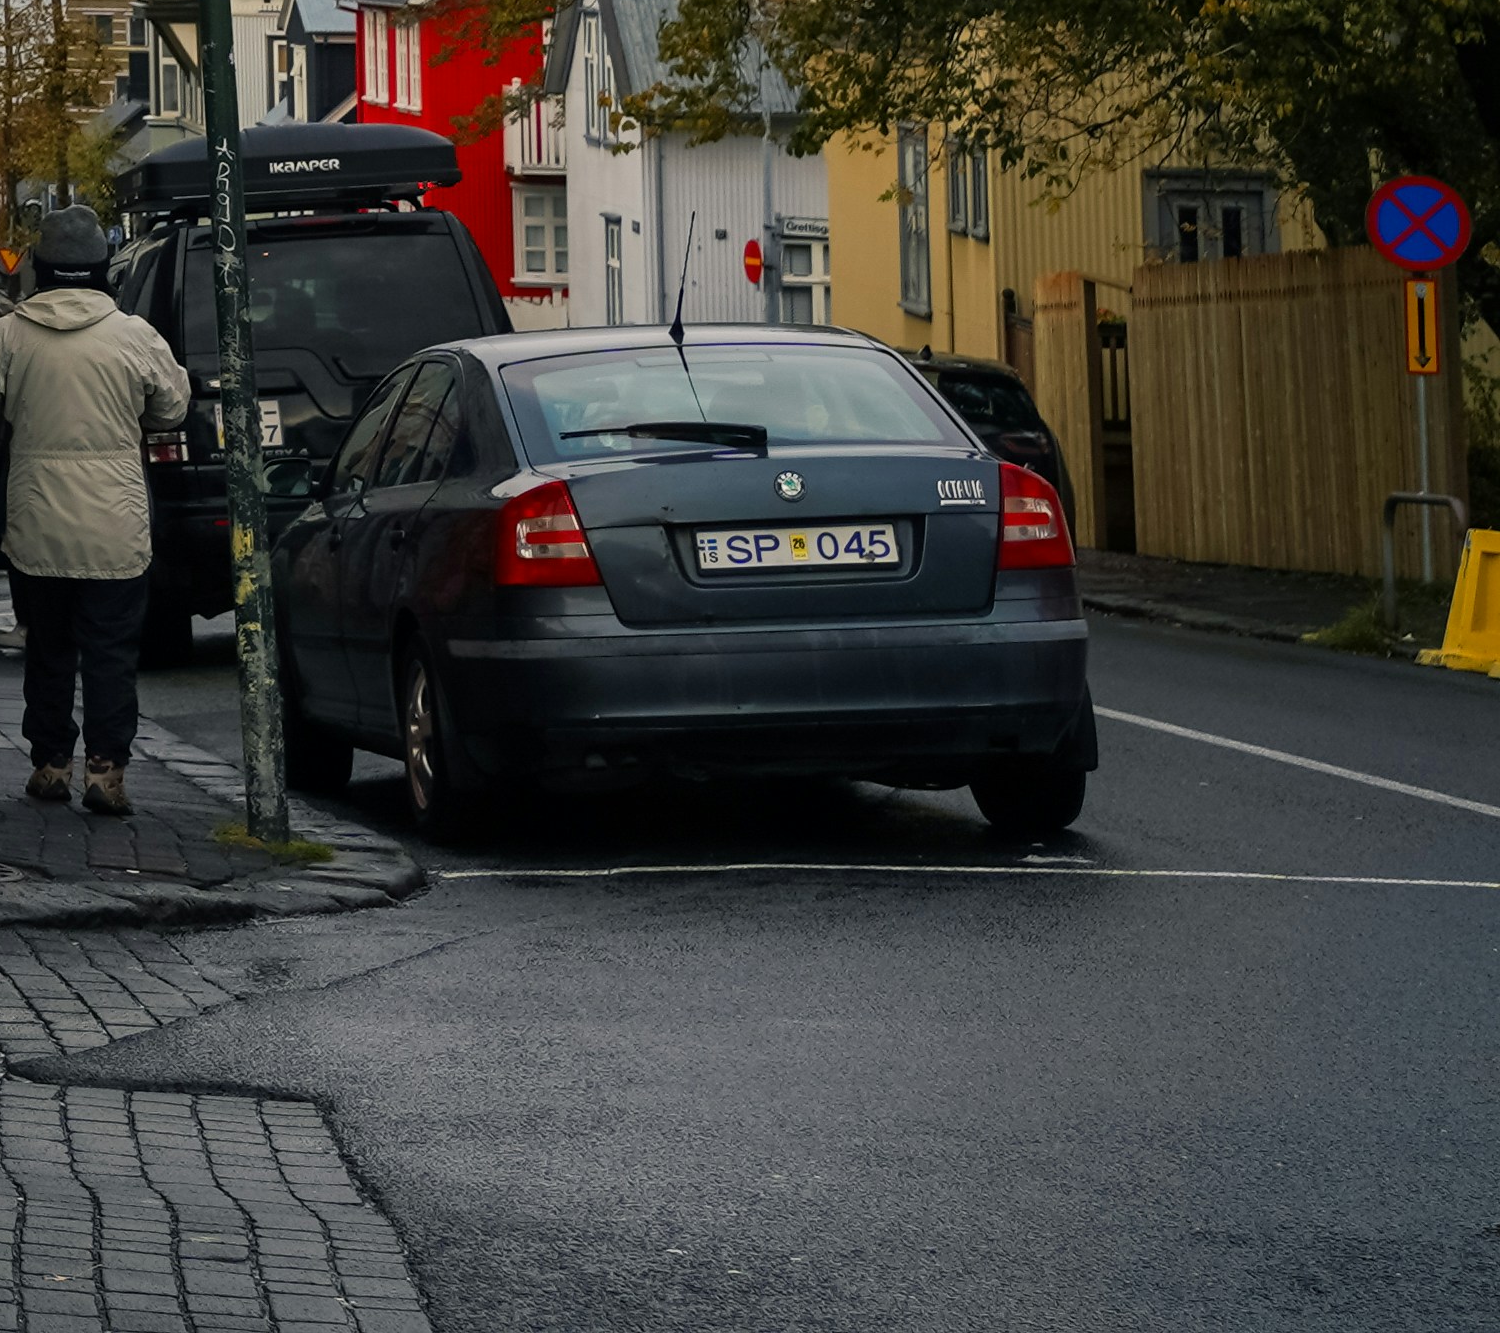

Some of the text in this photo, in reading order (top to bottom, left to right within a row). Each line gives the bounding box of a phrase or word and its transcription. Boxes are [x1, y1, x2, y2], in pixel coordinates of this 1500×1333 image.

[937, 479, 985, 500] OCTAVIA
[703, 552, 719, 564] IS
[727, 534, 780, 564] SP
[816, 530, 891, 561] 045
